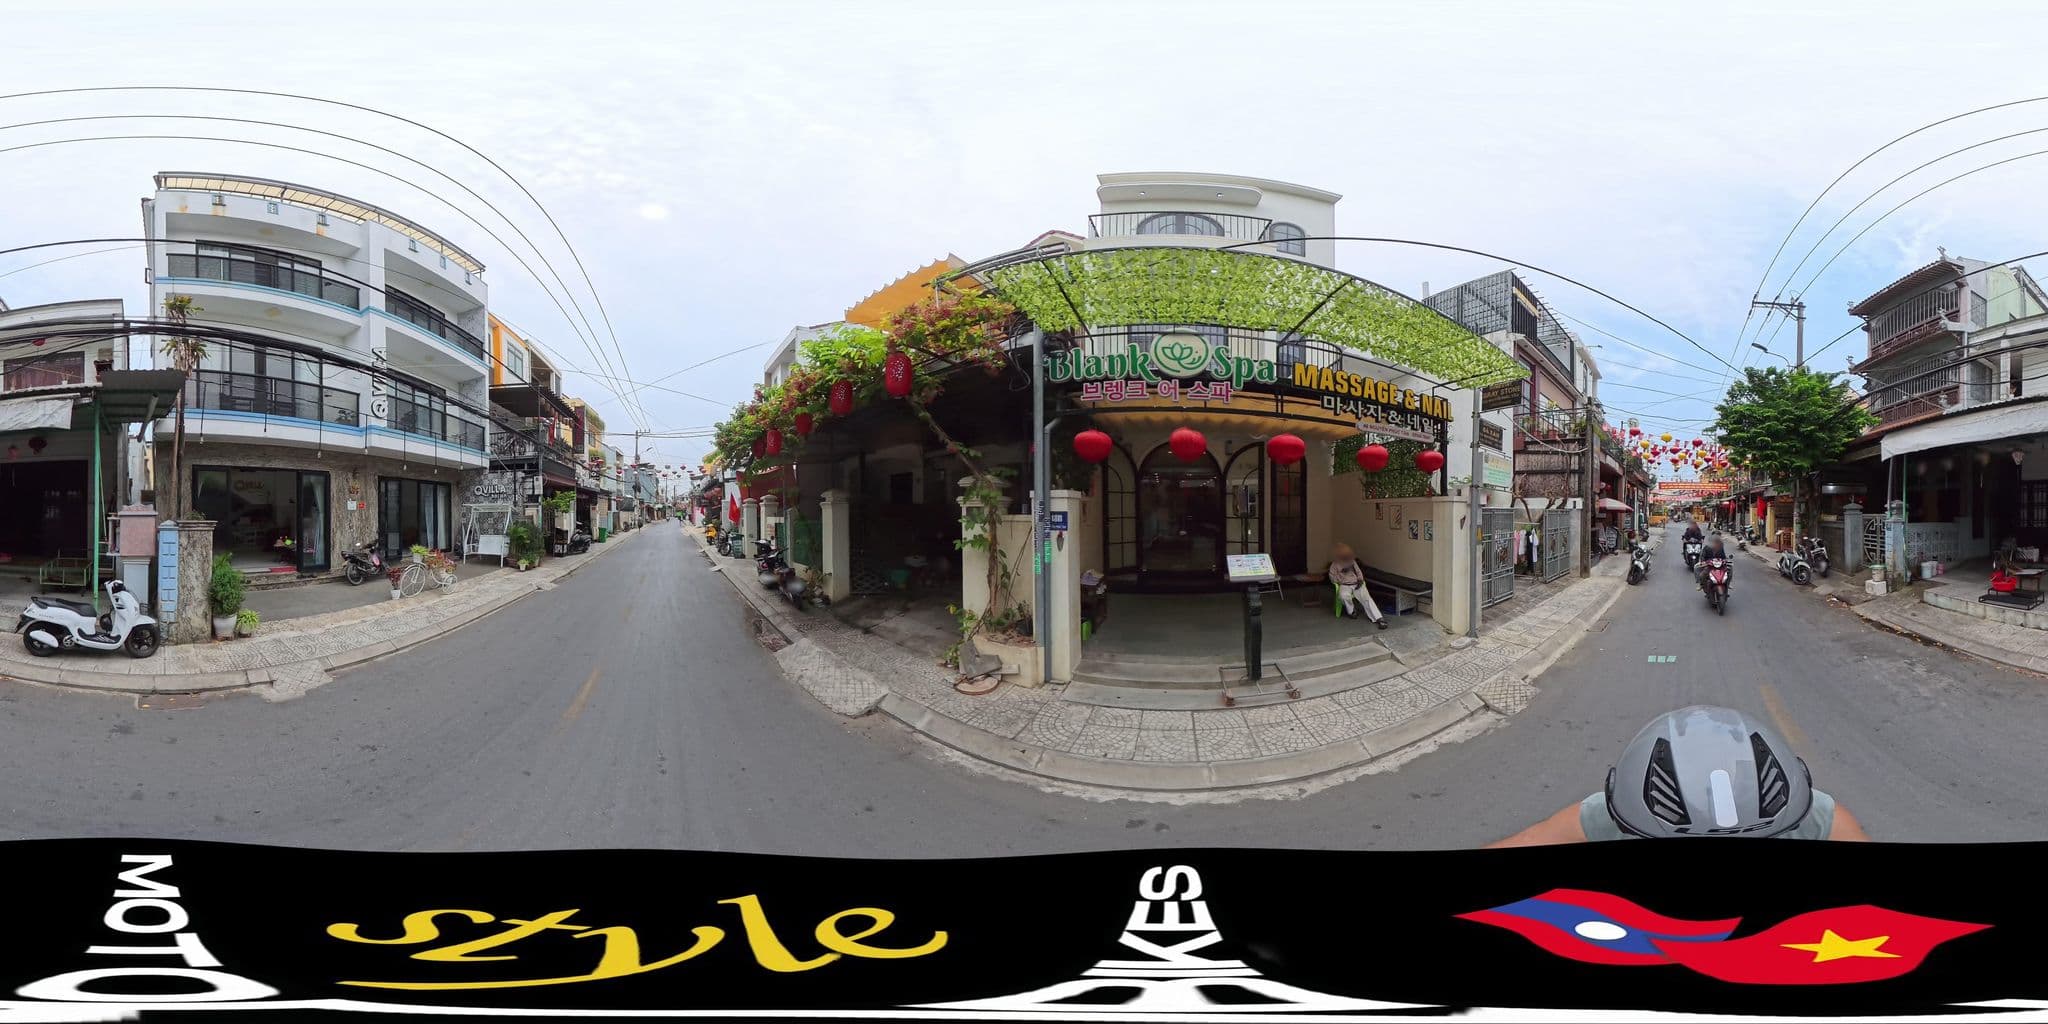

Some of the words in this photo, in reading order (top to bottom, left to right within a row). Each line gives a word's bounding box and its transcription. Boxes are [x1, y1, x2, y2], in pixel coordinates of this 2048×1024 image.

[1042, 343, 1161, 383] Blank
[1212, 345, 1277, 389] Spa
[1081, 380, 1148, 401] 브렝크
[1158, 379, 1179, 402] 어
[1187, 381, 1233, 403] 스파
[1293, 362, 1399, 405] MASSAGE
[1403, 388, 1417, 410] &
[1421, 393, 1454, 421] NAIL
[1322, 396, 1382, 421] 마사지
[1388, 410, 1403, 424] &
[474, 485, 506, 497] QVILLA
